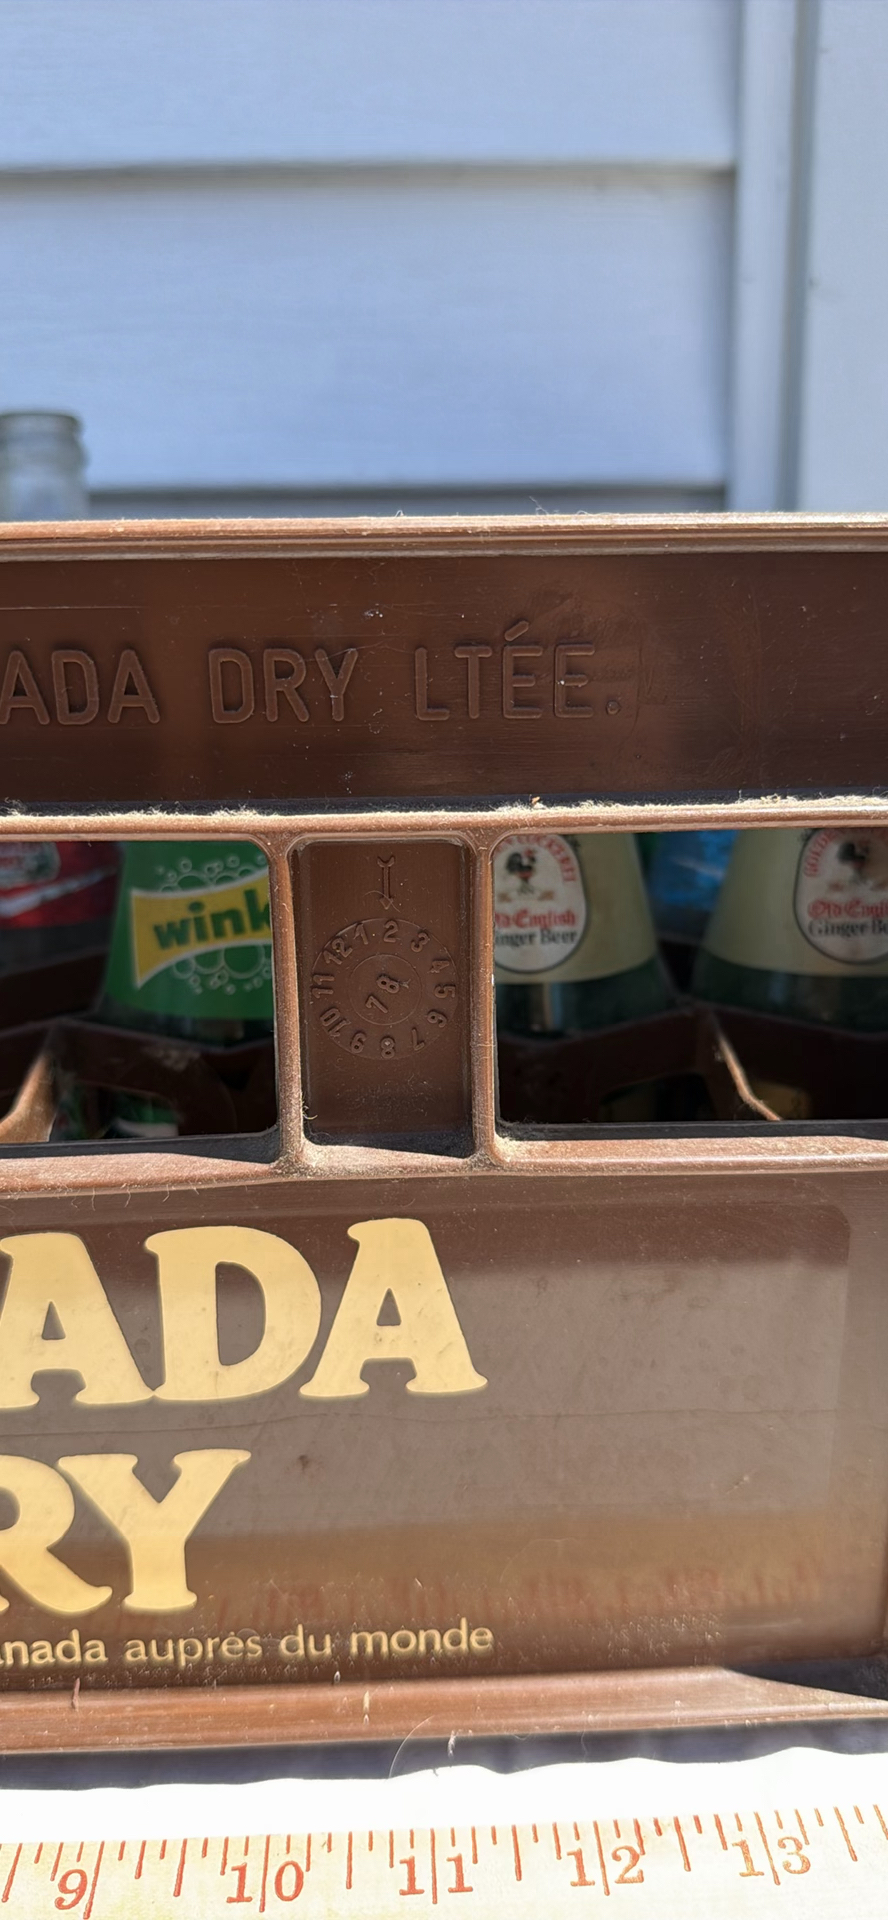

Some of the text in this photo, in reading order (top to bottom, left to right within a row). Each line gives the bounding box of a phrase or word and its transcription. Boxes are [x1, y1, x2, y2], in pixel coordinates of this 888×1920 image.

[0, 620, 622, 725] ADA DRY LTÉE.
[513, 908, 576, 929] English
[808, 919, 868, 939] Ginger
[353, 922, 369, 945] 1
[383, 920, 399, 943] 2
[411, 931, 430, 953] 3
[540, 927, 578, 945] Beer
[323, 937, 353, 965] 12
[430, 960, 450, 974] 4
[311, 974, 335, 999] 11
[434, 984, 456, 999] 5
[320, 1008, 351, 1038] 10
[427, 1011, 447, 1028] 6
[380, 1037, 396, 1059] 8
[411, 1028, 425, 1051] 7
[0, 1217, 488, 1409] ADA
[0, 1448, 252, 1614] RY
[0, 1628, 108, 1665] nada
[280, 1623, 331, 1657] du
[350, 1616, 494, 1659] monde
[54, 1868, 88, 1910] 9
